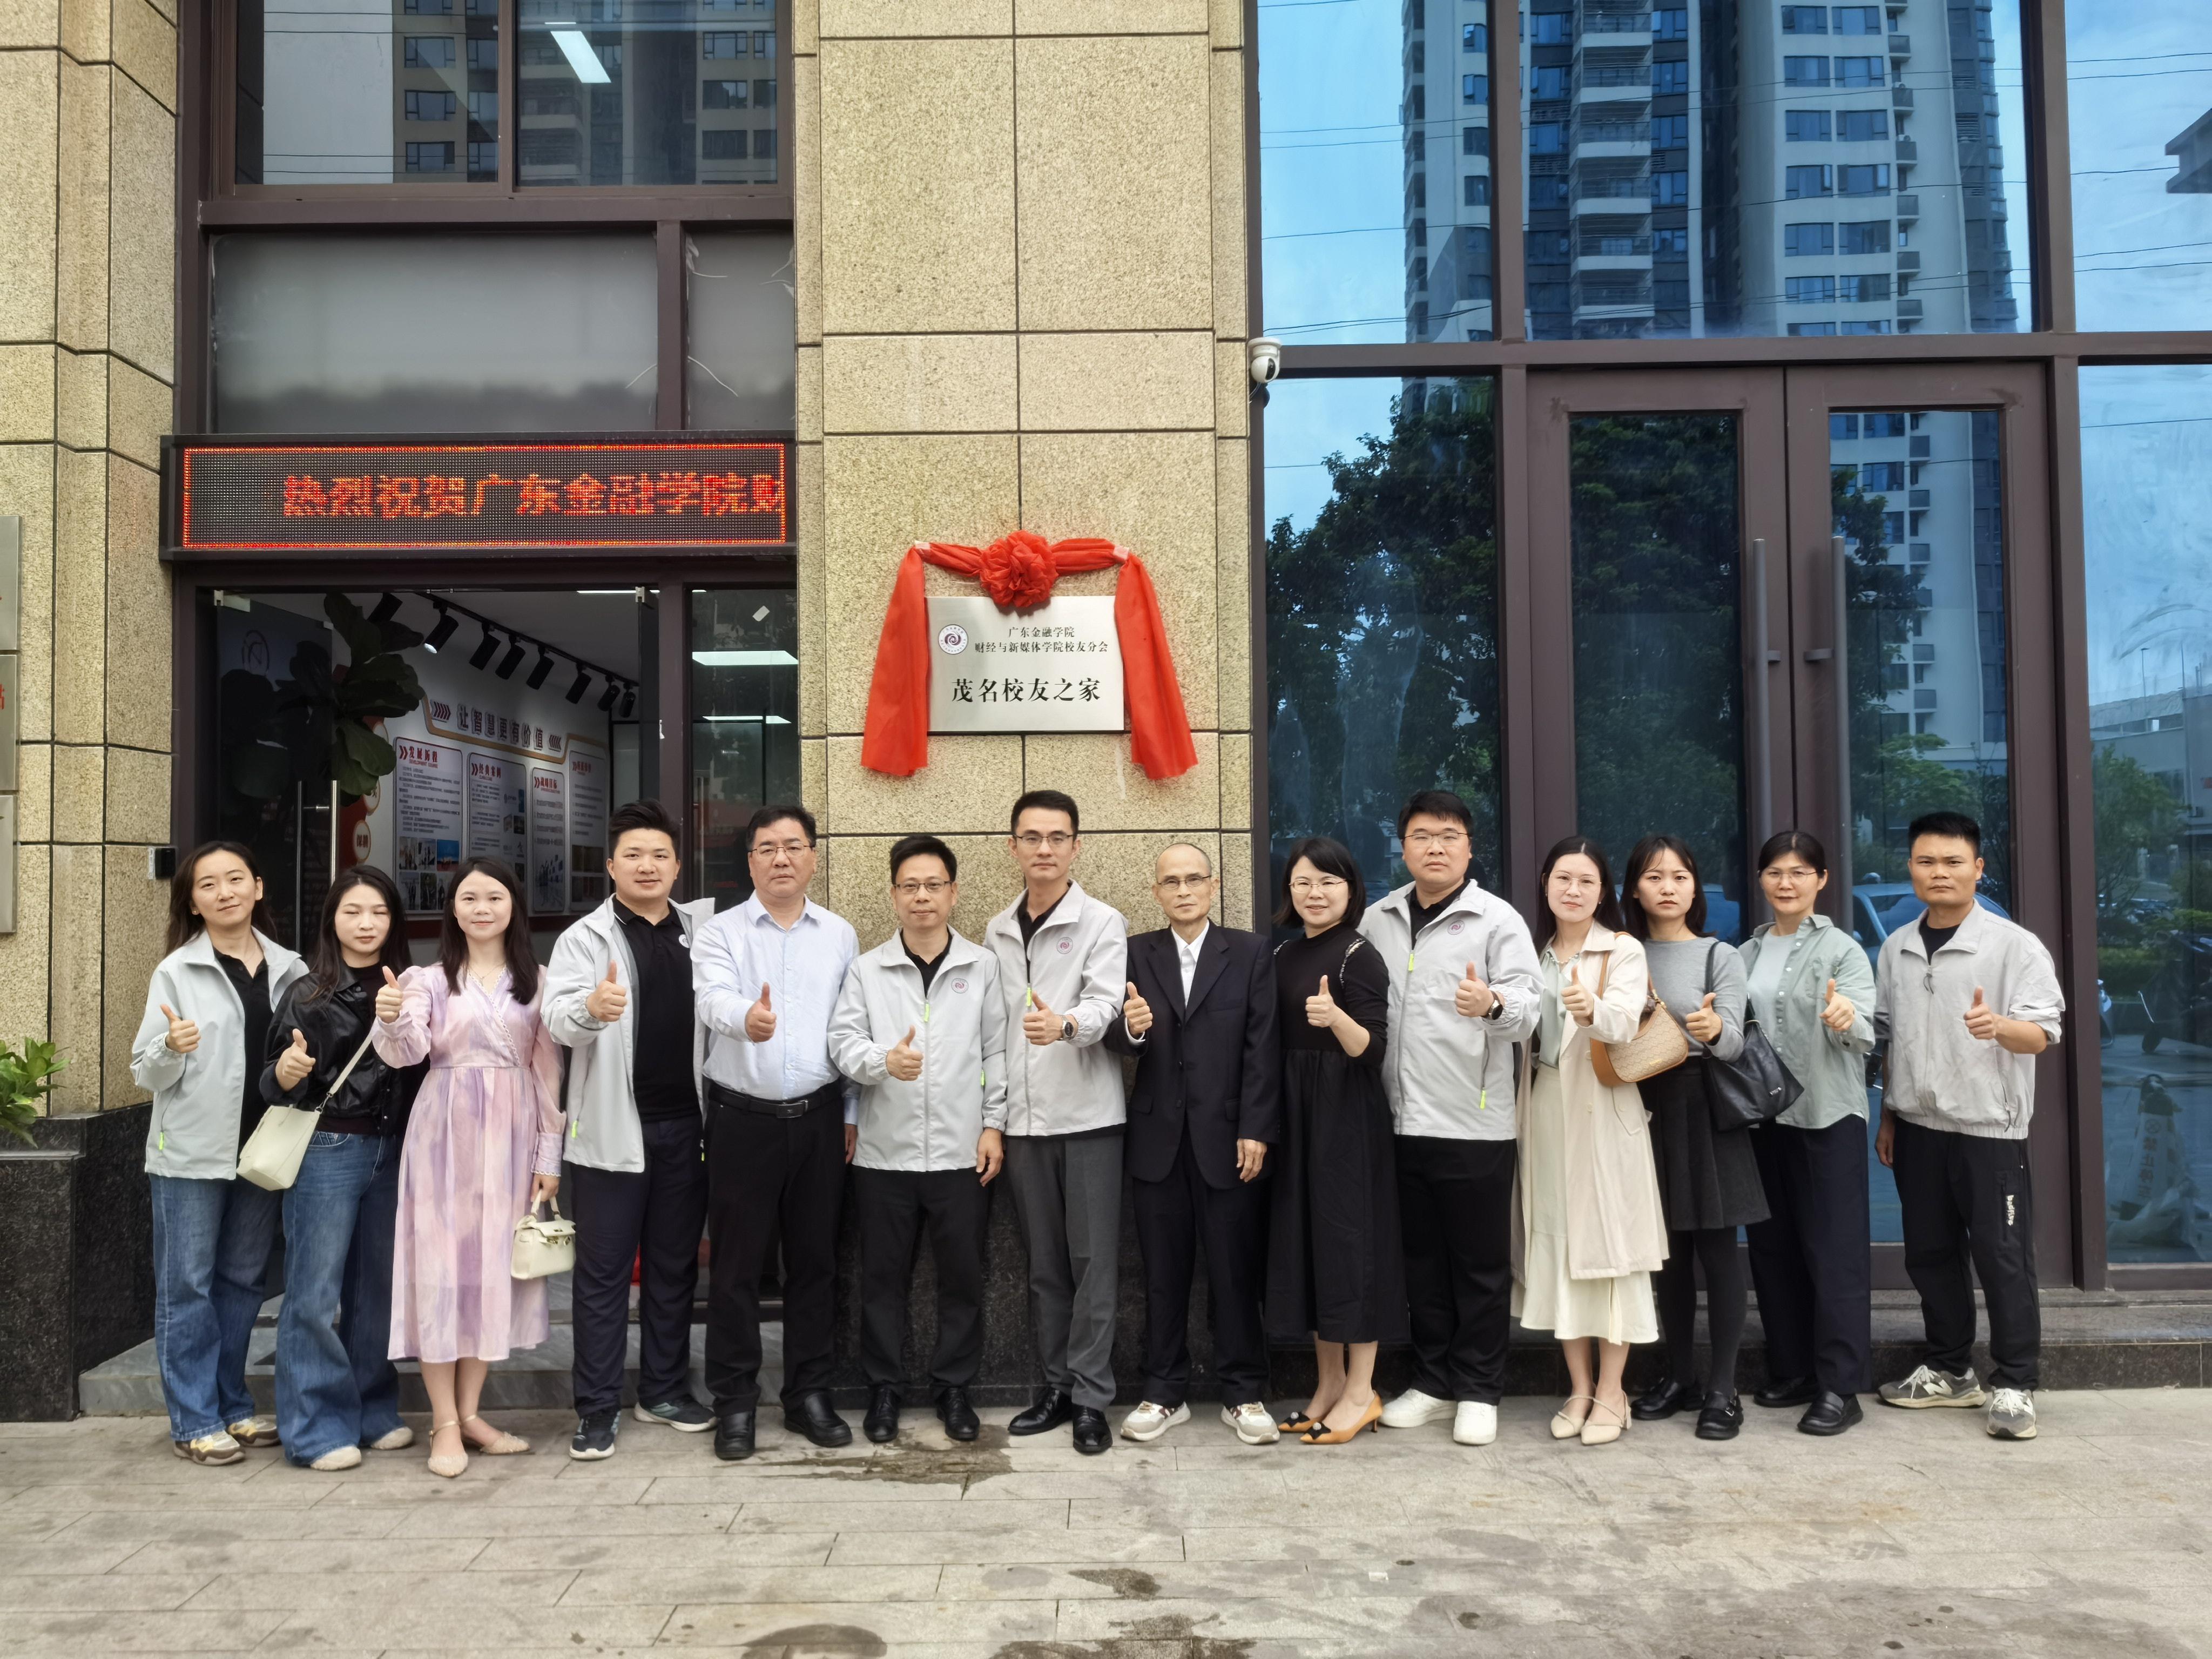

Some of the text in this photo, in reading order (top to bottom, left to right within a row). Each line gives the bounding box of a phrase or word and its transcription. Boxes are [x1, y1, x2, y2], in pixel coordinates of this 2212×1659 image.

[1008, 626, 1075, 638] 广东金融学院
[974, 641, 1108, 653] 财经与新媒体学院校友分会
[952, 677, 1101, 703] 茂名校友之家
[460, 705, 543, 748] 让智慧更有价值
